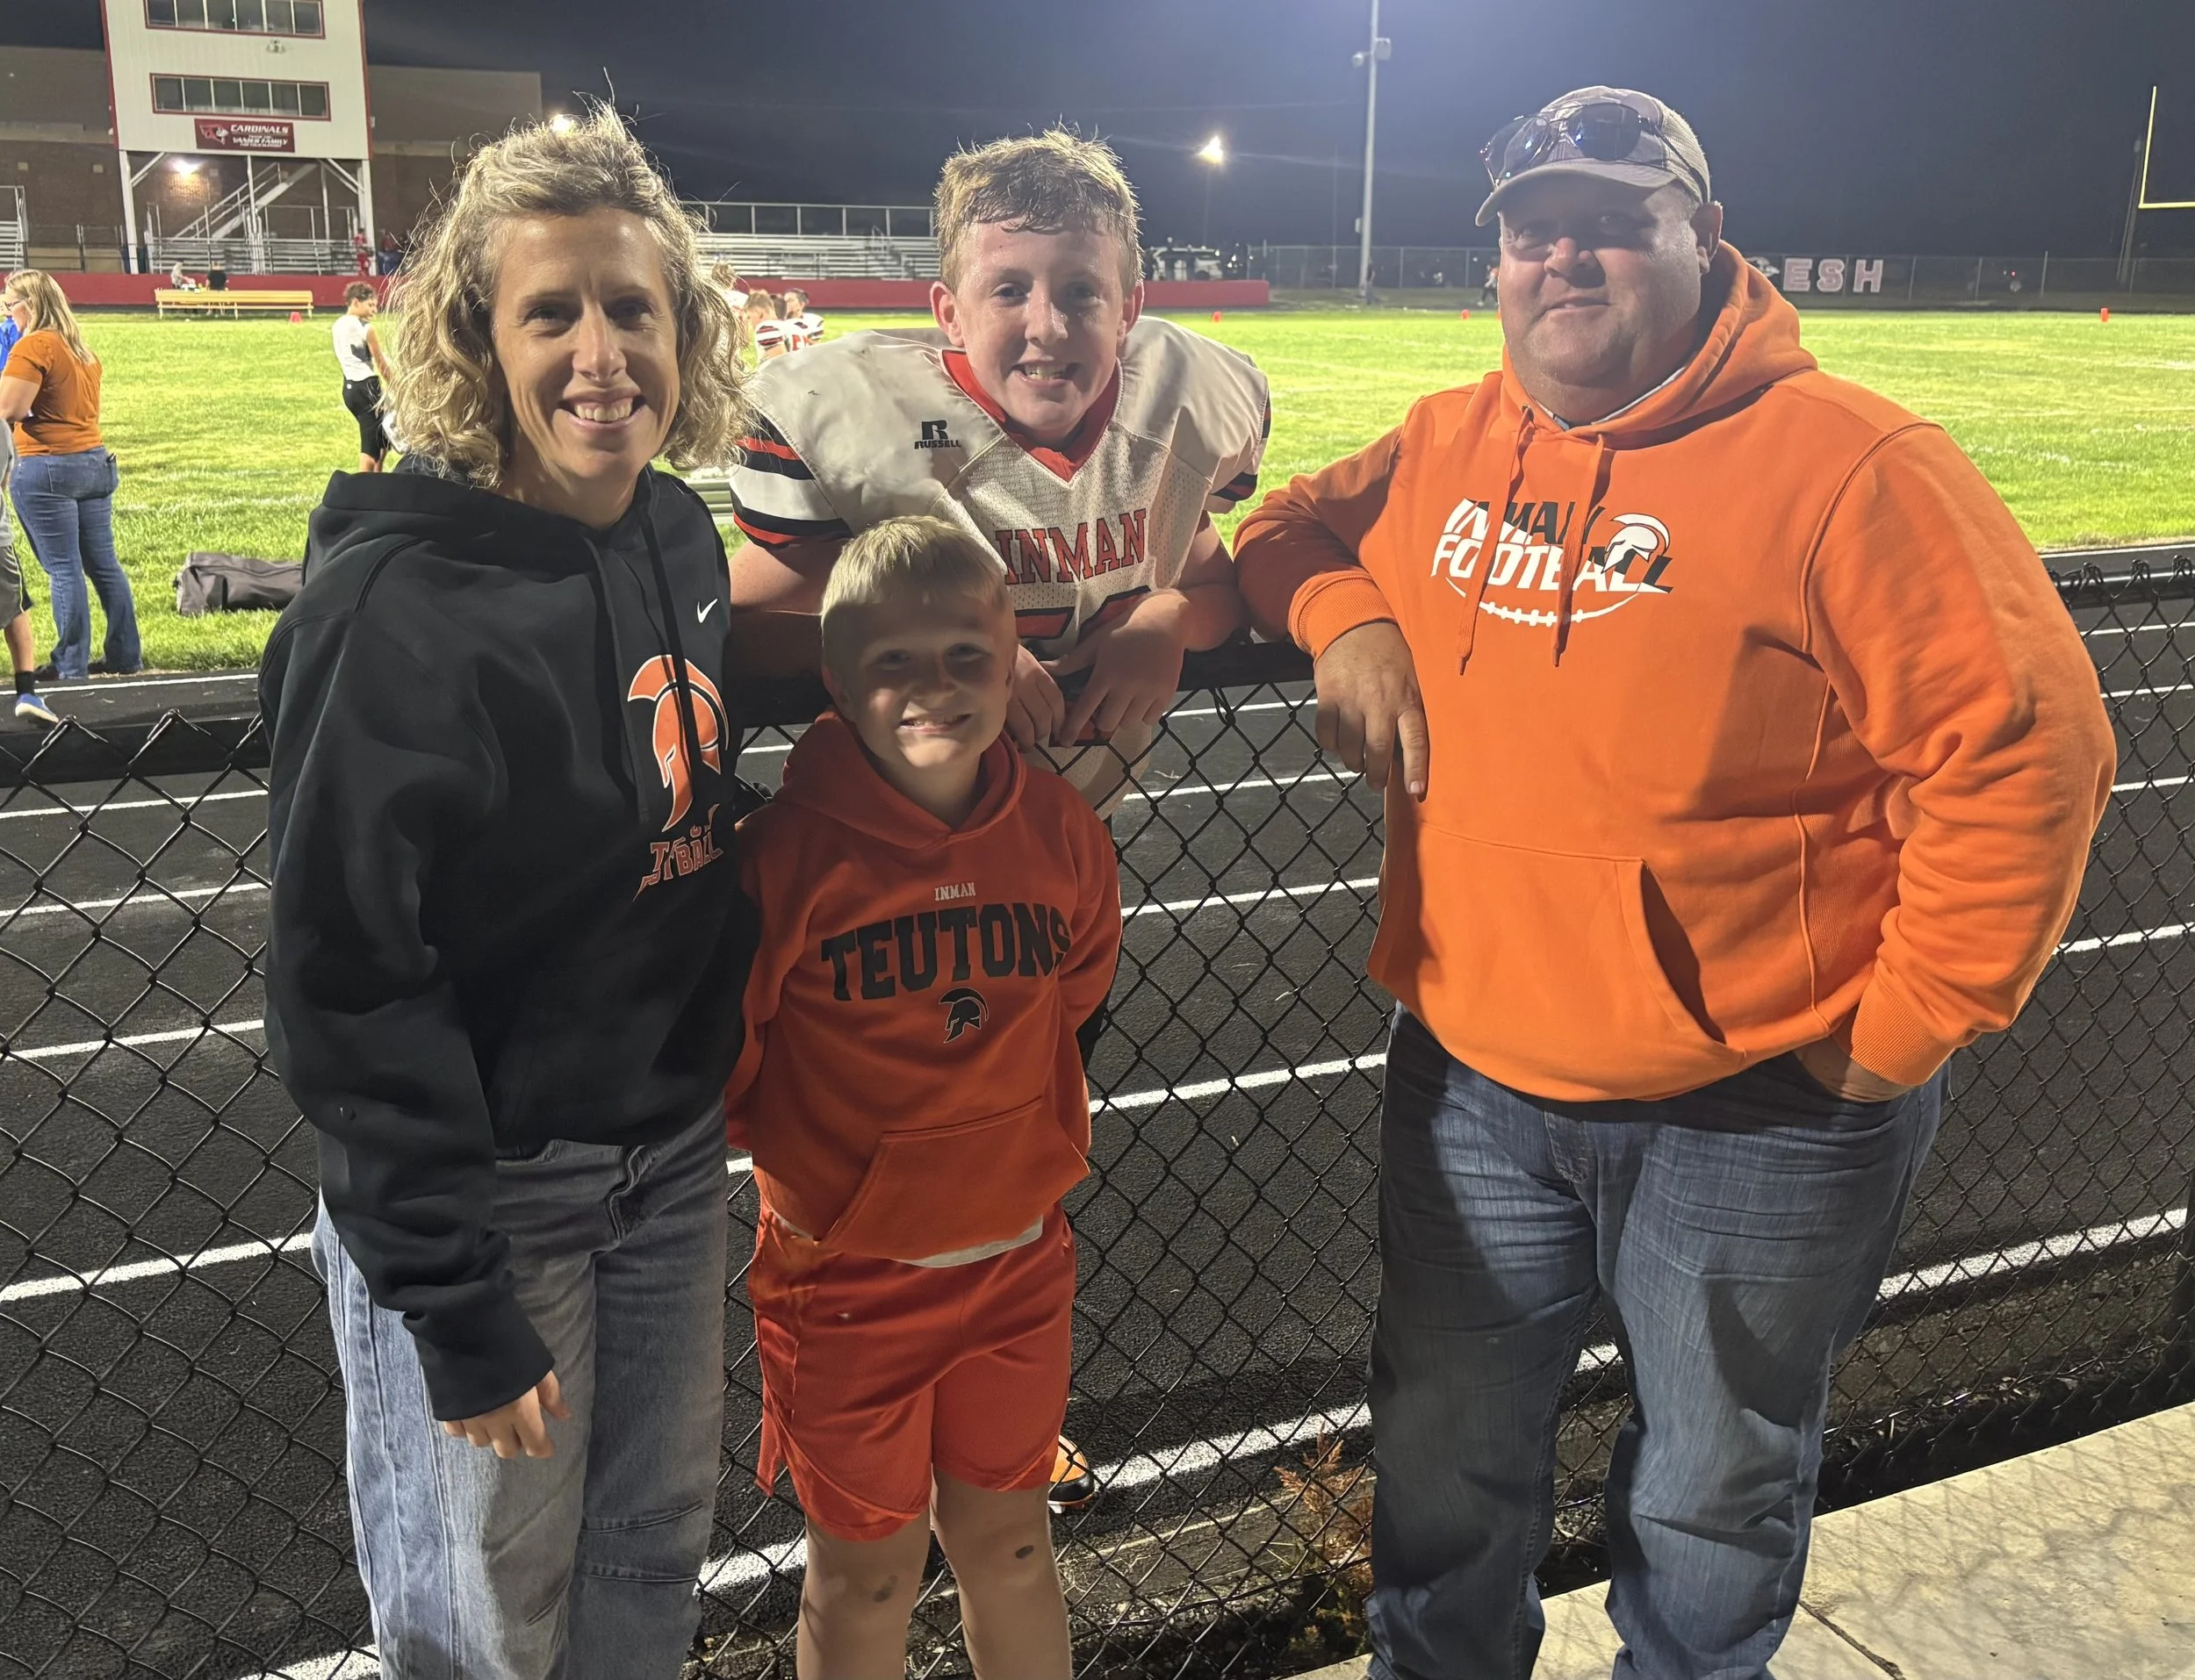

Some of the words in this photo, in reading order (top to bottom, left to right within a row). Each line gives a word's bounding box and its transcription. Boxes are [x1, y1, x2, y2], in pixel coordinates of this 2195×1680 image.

[230, 124, 290, 134] CARDINALS
[1782, 258, 1884, 293] ESH
[922, 420, 948, 441] R
[914, 439, 961, 449] RUSSELL
[996, 507, 1147, 585] INMAN
[934, 881, 976, 901] INMAN
[821, 901, 1071, 1002] TEUTONS
